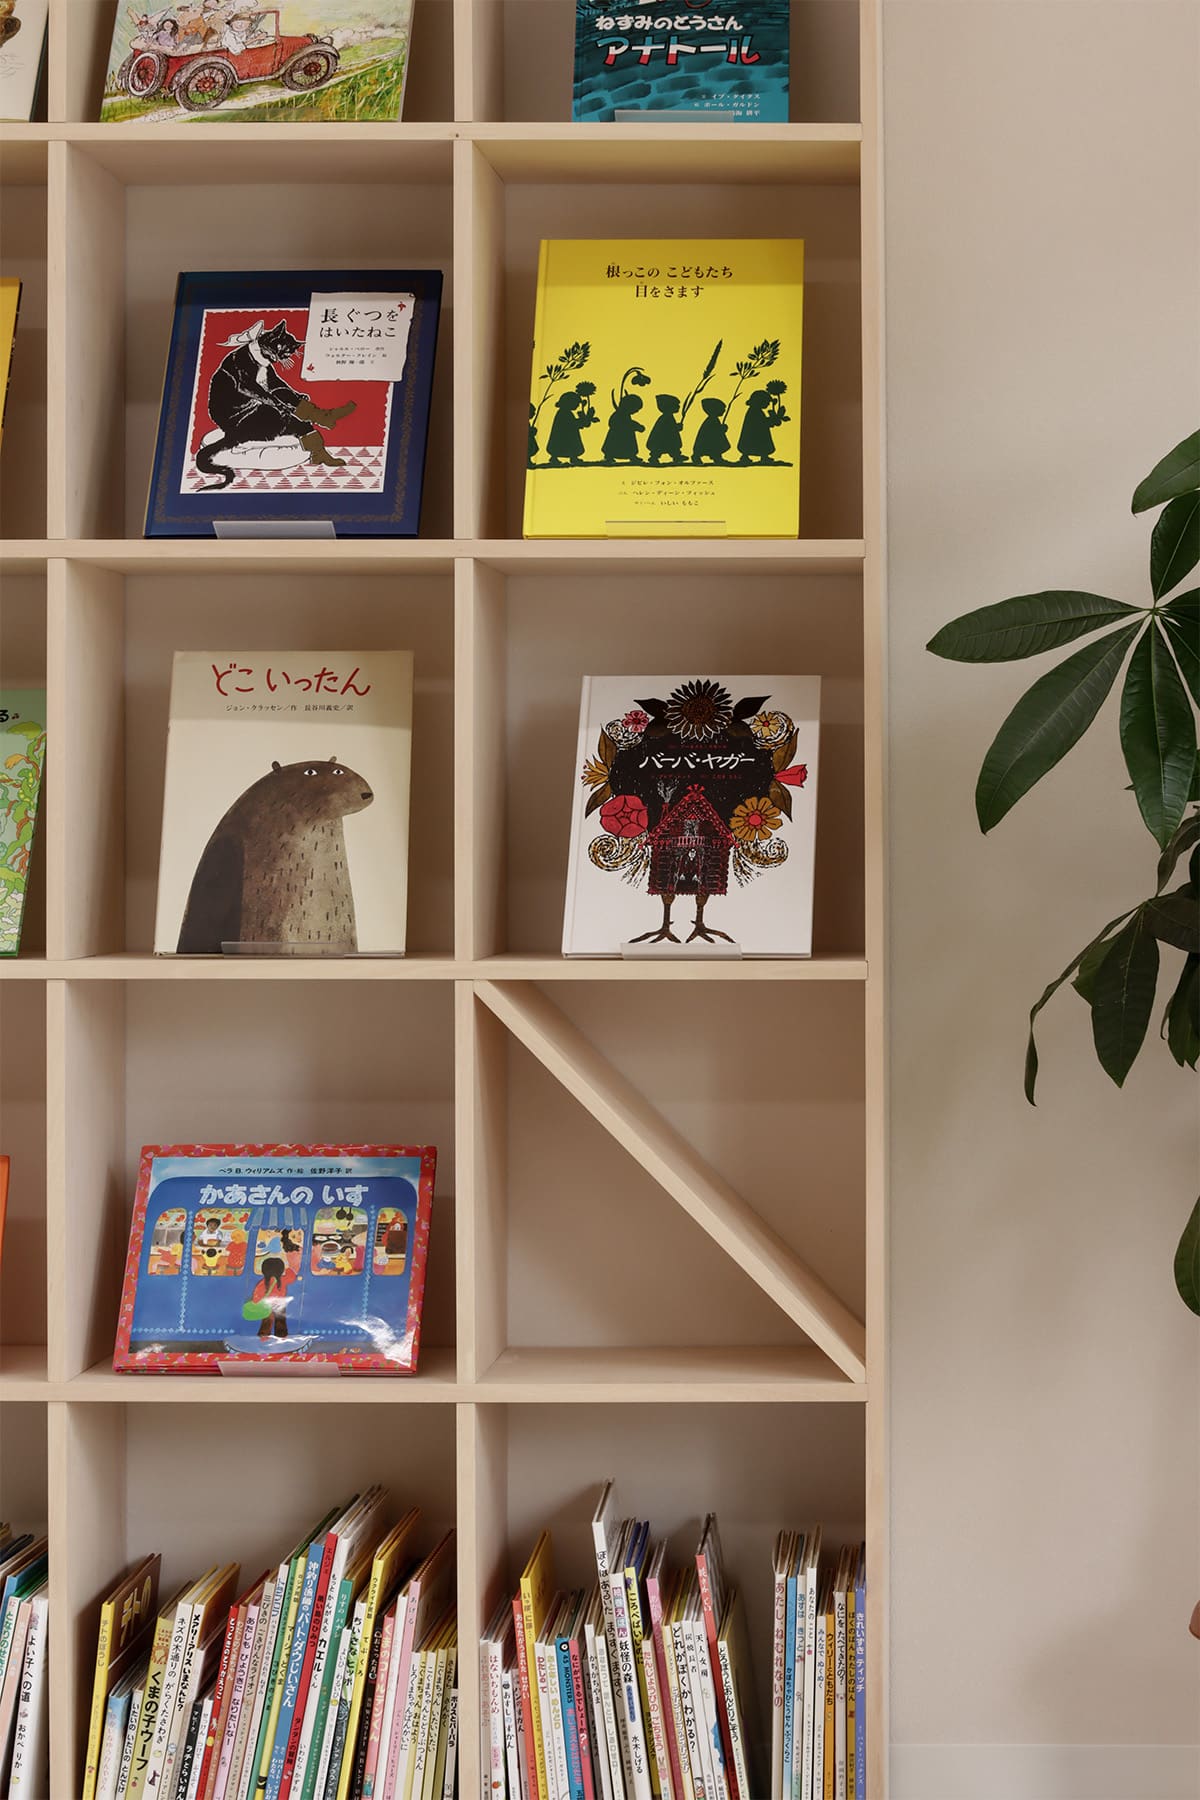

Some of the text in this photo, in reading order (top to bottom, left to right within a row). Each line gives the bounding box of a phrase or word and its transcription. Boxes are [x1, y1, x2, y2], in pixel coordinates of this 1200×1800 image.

[595, 15, 743, 31] ねずみのとうさん
[596, 35, 761, 65] アナトール
[606, 265, 733, 278] 根っこの こどもたち
[635, 285, 704, 298] 目をさます
[319, 326, 396, 338] はいたねこ
[320, 307, 399, 324] 長ぐつを
[211, 663, 372, 697] どこ いったん
[638, 752, 756, 770] バーバ・ヤガー
[200, 1184, 369, 1207] かあさんの いす
[597, 1551, 609, 1578] ぼくは
[601, 1580, 614, 1616] あるいた
[242, 1617, 256, 1649] あたしも
[244, 1595, 272, 1696] 三びきの ごきげんなライオン
[342, 1616, 362, 1687] ちいさなヒッポ
[607, 1621, 620, 1660] まっすぐ
[21, 1635, 37, 1703] よい子への道
[357, 1636, 370, 1677] てぶくろ
[620, 1641, 634, 1683] 妖怪の森
[816, 1628, 825, 1689] みんなで ぬくぬく
[855, 1612, 865, 1694] きれいずき ティッチ
[369, 1624, 392, 1743] くまのコールテンくん
[489, 1655, 500, 1714] はないちもんめ
[564, 1667, 574, 1704] MONSTERS
[612, 1661, 623, 1698] まっすぐ
[643, 1651, 659, 1712] たんじょうびの
[673, 1627, 692, 1700] どれがぼくか
[684, 1704, 696, 1753] わかる?
[129, 1704, 140, 1731] いたいの
[136, 1671, 162, 1771] くまの子ウーフ
[156, 1683, 176, 1744] がらくたさわぎ
[415, 1666, 434, 1771] こぐまちゃんとどうぶつえん
[503, 1691, 515, 1749] おすしのずかん
[551, 1698, 562, 1730] めんどり
[123, 1734, 134, 1762] いたいの
[631, 1735, 643, 1774] 水木しげる
